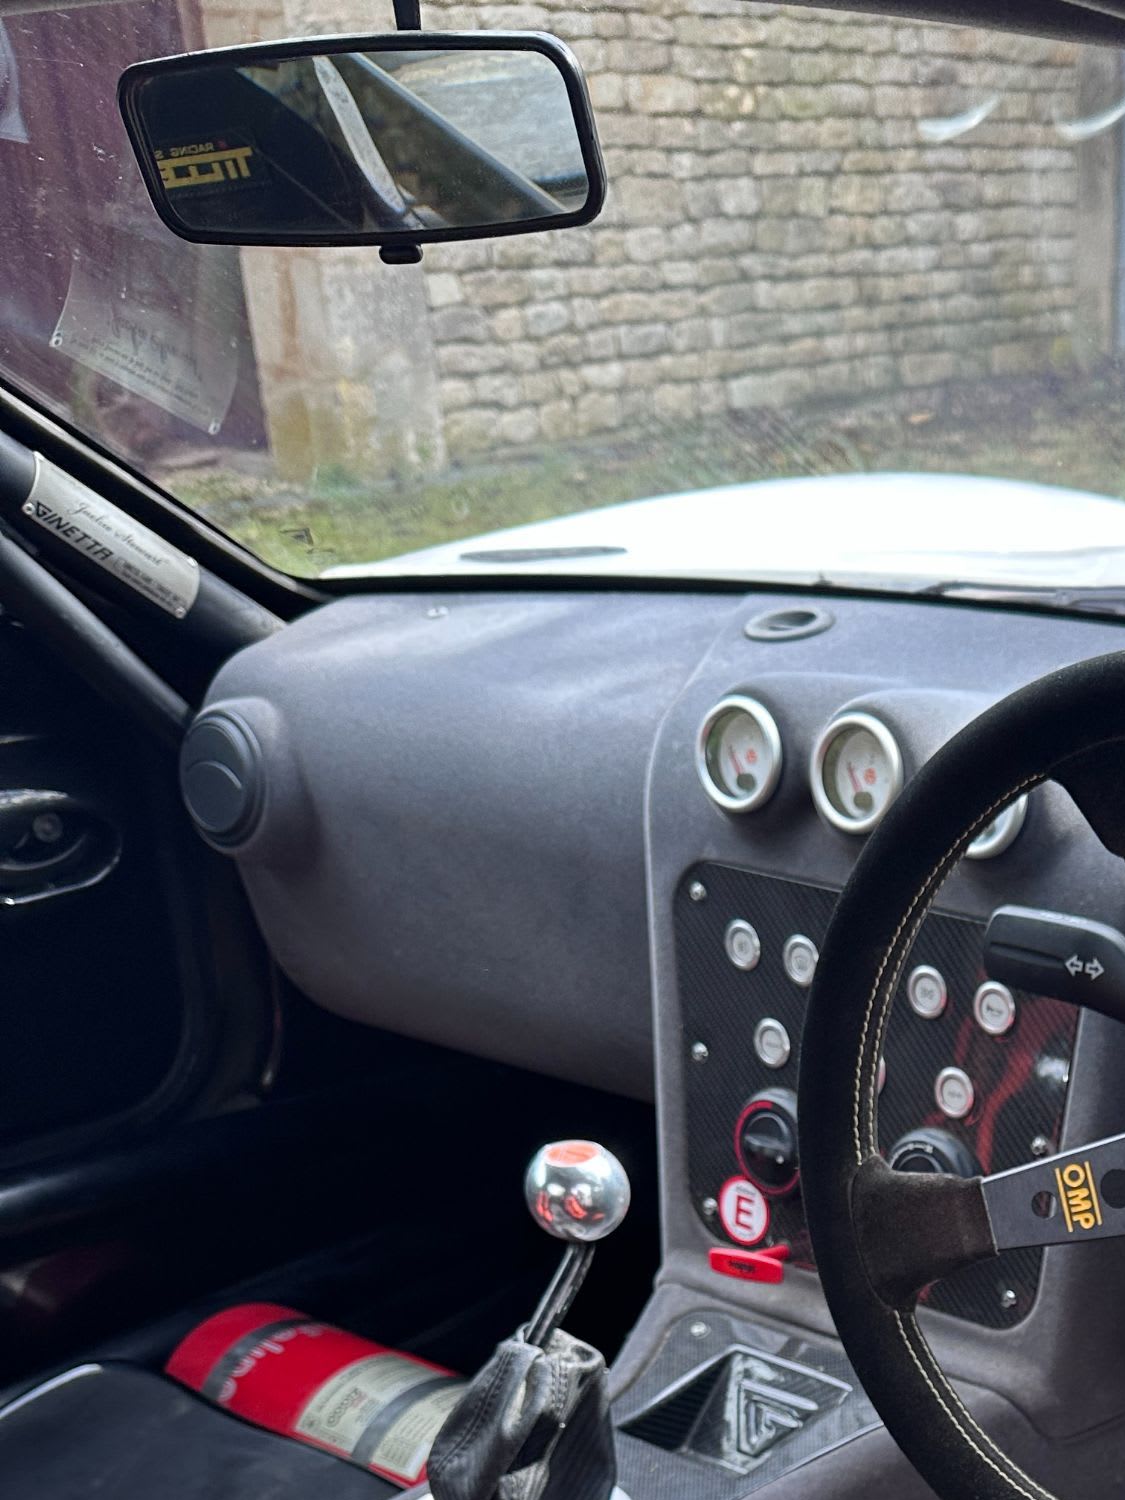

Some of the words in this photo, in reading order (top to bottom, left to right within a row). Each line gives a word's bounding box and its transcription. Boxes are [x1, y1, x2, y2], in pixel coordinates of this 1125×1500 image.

[33, 501, 115, 562] GINETTA
[735, 1194, 755, 1231] E
[1062, 1163, 1096, 1230] OMP
